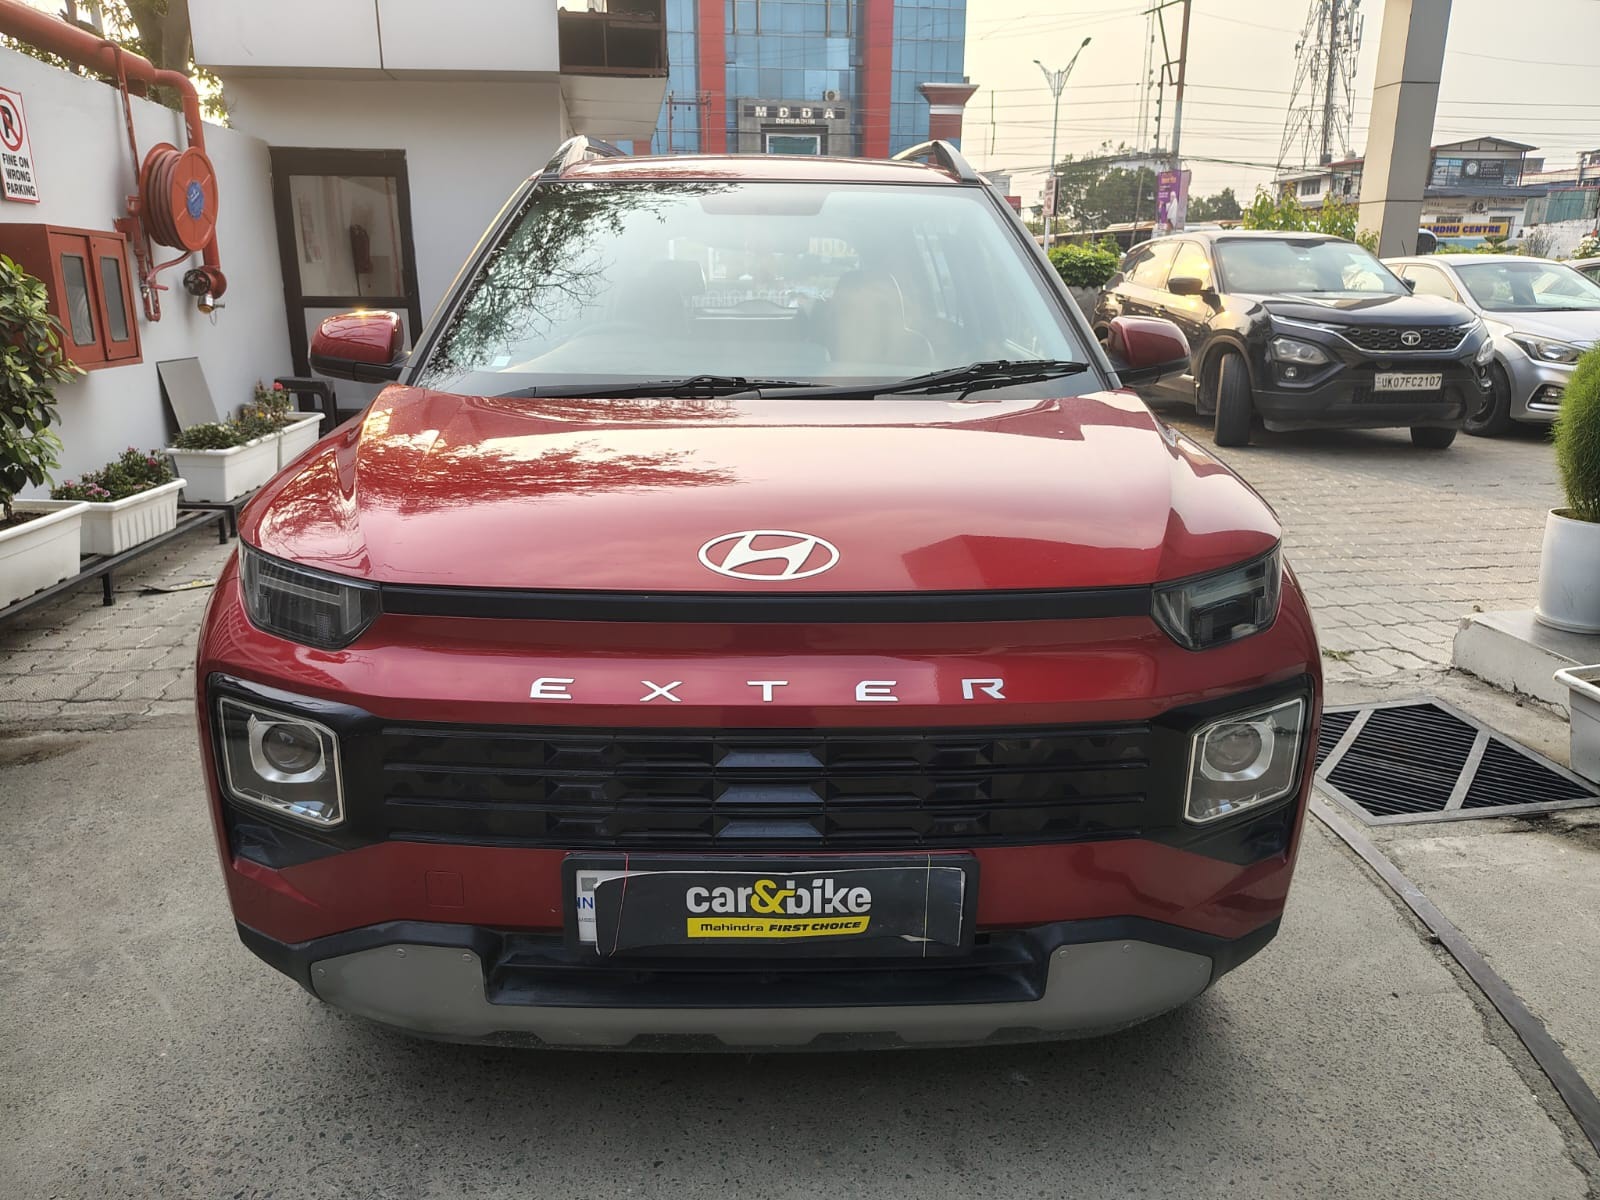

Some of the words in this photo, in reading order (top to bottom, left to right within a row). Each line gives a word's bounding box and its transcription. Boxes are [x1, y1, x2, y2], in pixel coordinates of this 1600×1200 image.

[2, 153, 18, 167] FINE
[18, 156, 30, 169] ON
[5, 168, 31, 182] WRONG
[6, 182, 36, 197] PARKING
[1382, 376, 1441, 388] UK07FC2107
[530, 677, 1006, 702] EXTER
[577, 896, 594, 909] IN
[686, 878, 872, 915] car&bike
[700, 923, 764, 932] Mahindra
[769, 923, 808, 932] FIRST
[811, 921, 862, 931] CHOICE
